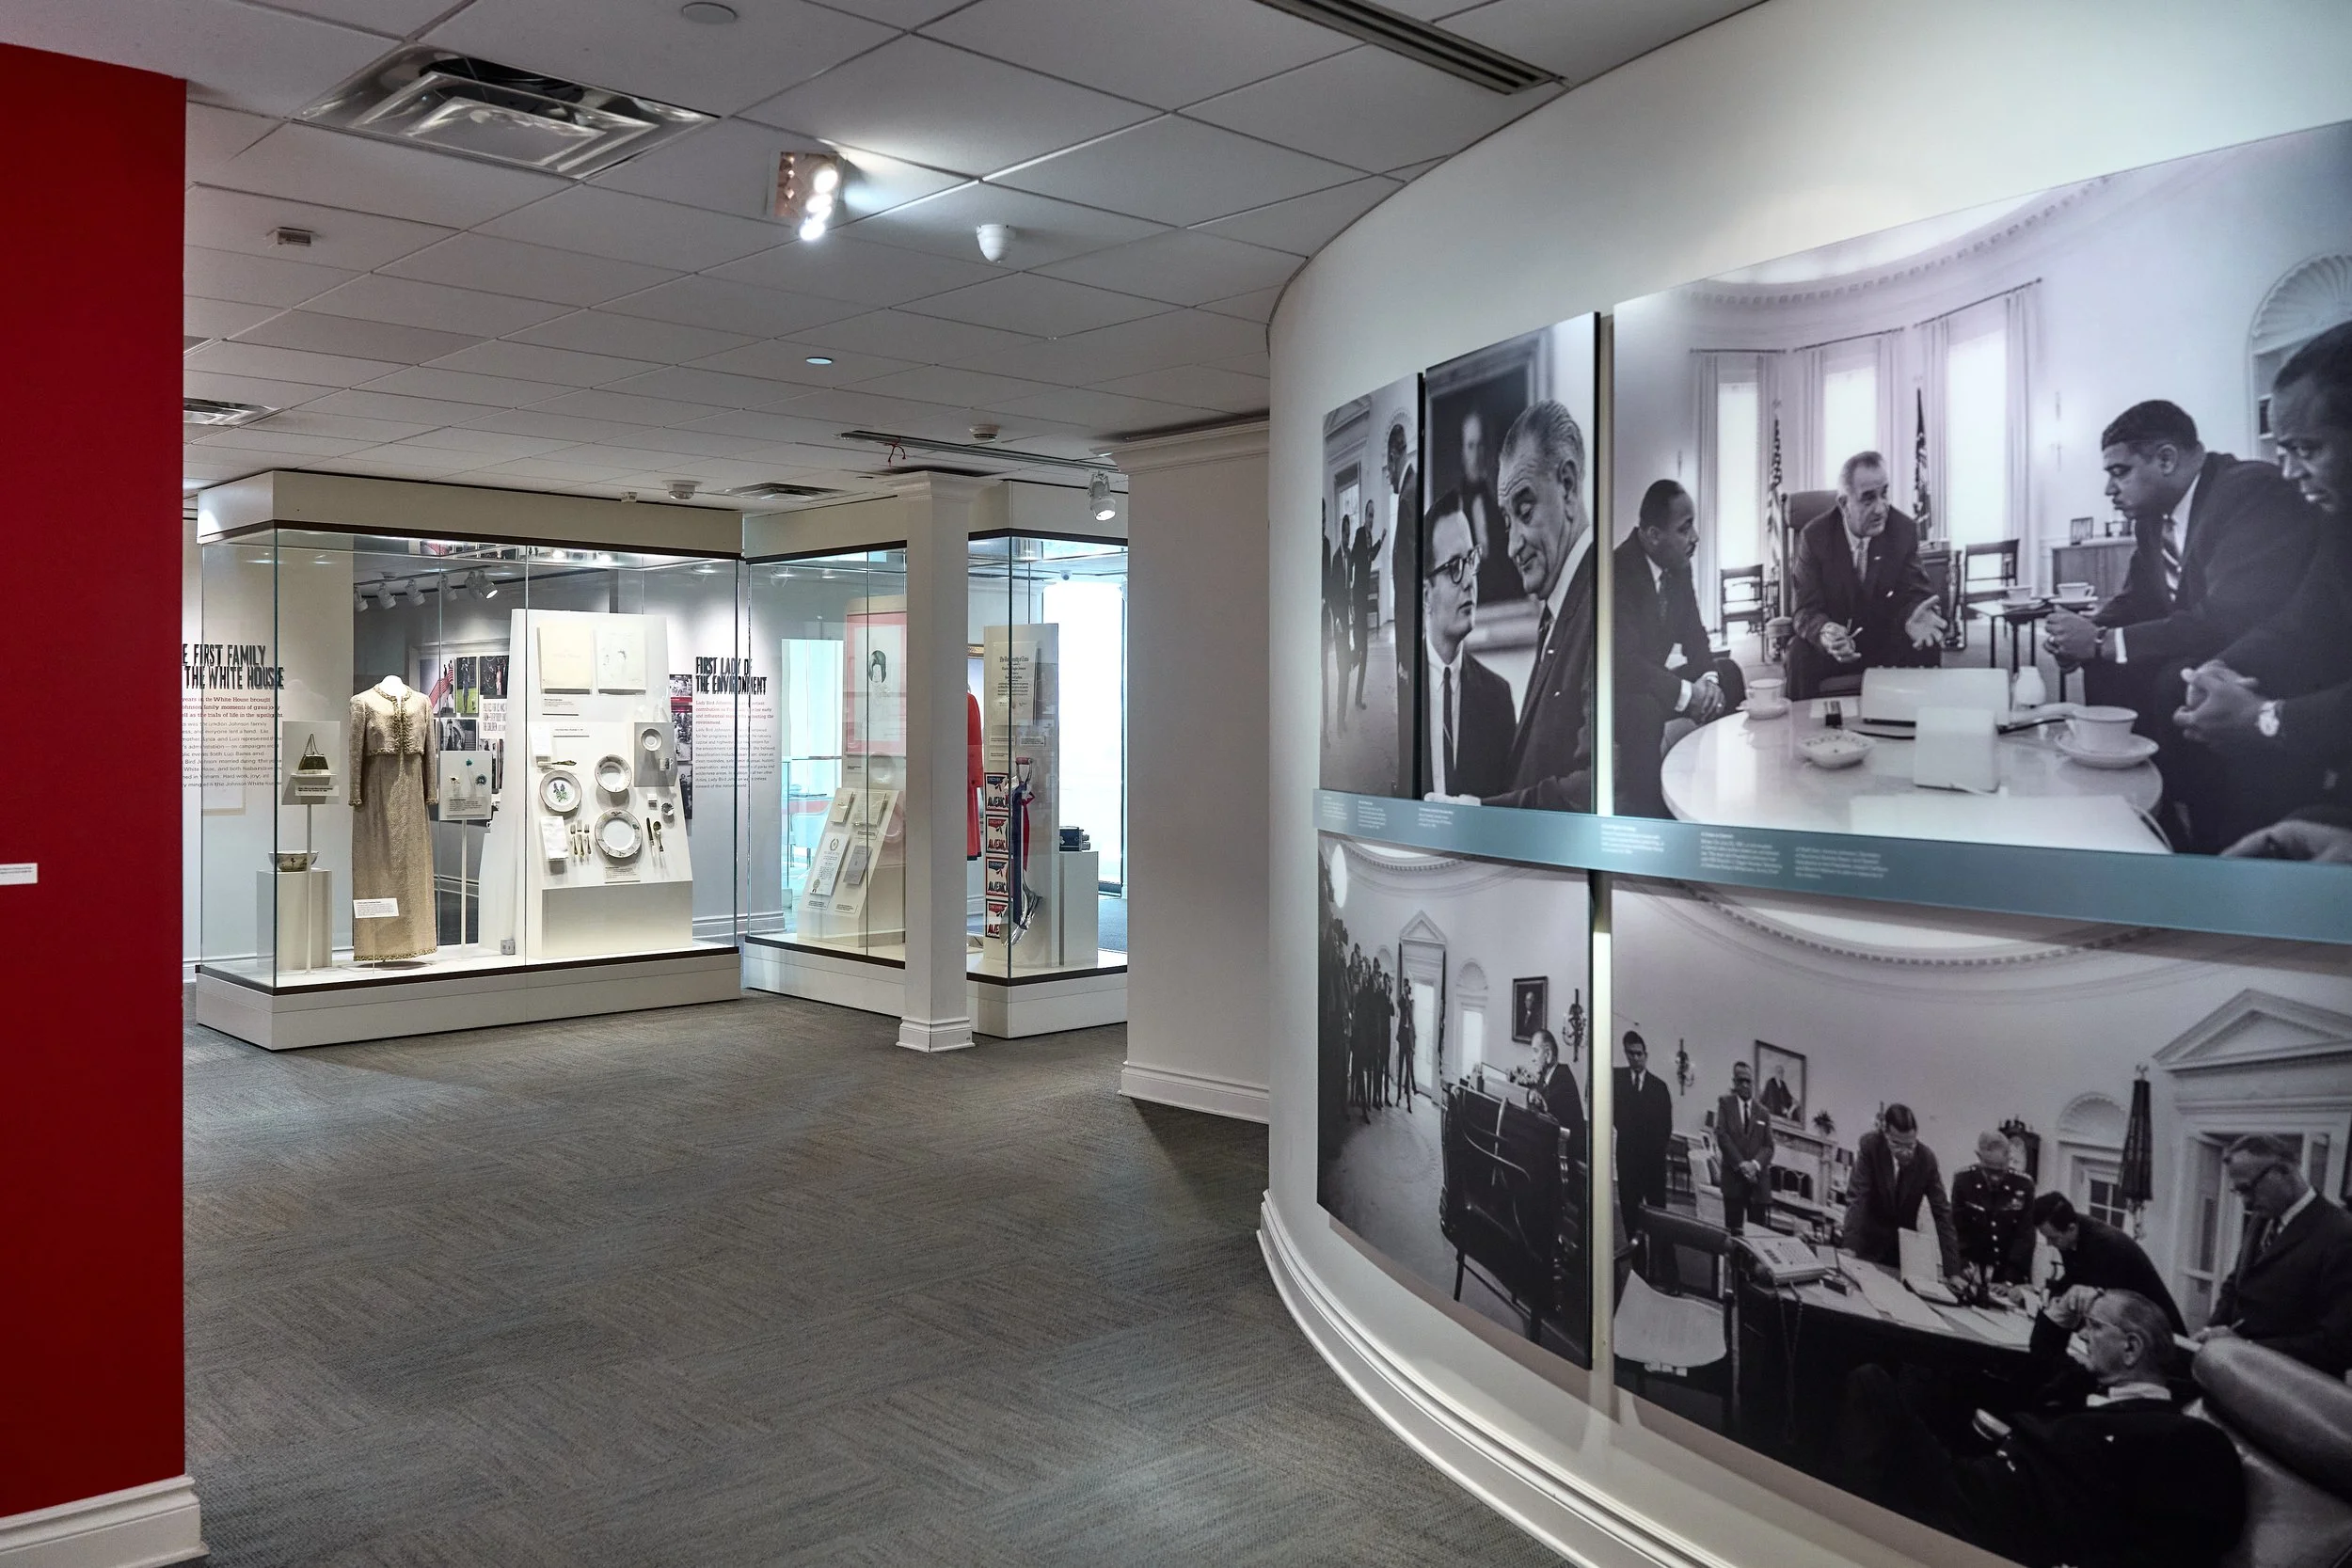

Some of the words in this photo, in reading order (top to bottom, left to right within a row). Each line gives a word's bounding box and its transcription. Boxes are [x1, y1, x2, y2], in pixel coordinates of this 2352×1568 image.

[194, 643, 223, 667] FIRST
[228, 644, 265, 667] FAMILY
[695, 657, 718, 674] FIRST
[721, 657, 741, 675] LADY
[184, 666, 205, 689] THE
[209, 666, 243, 689] WHITE
[247, 666, 285, 690] HOUSE
[695, 675, 709, 693] THE
[712, 675, 768, 695] ENVIRONMENT
